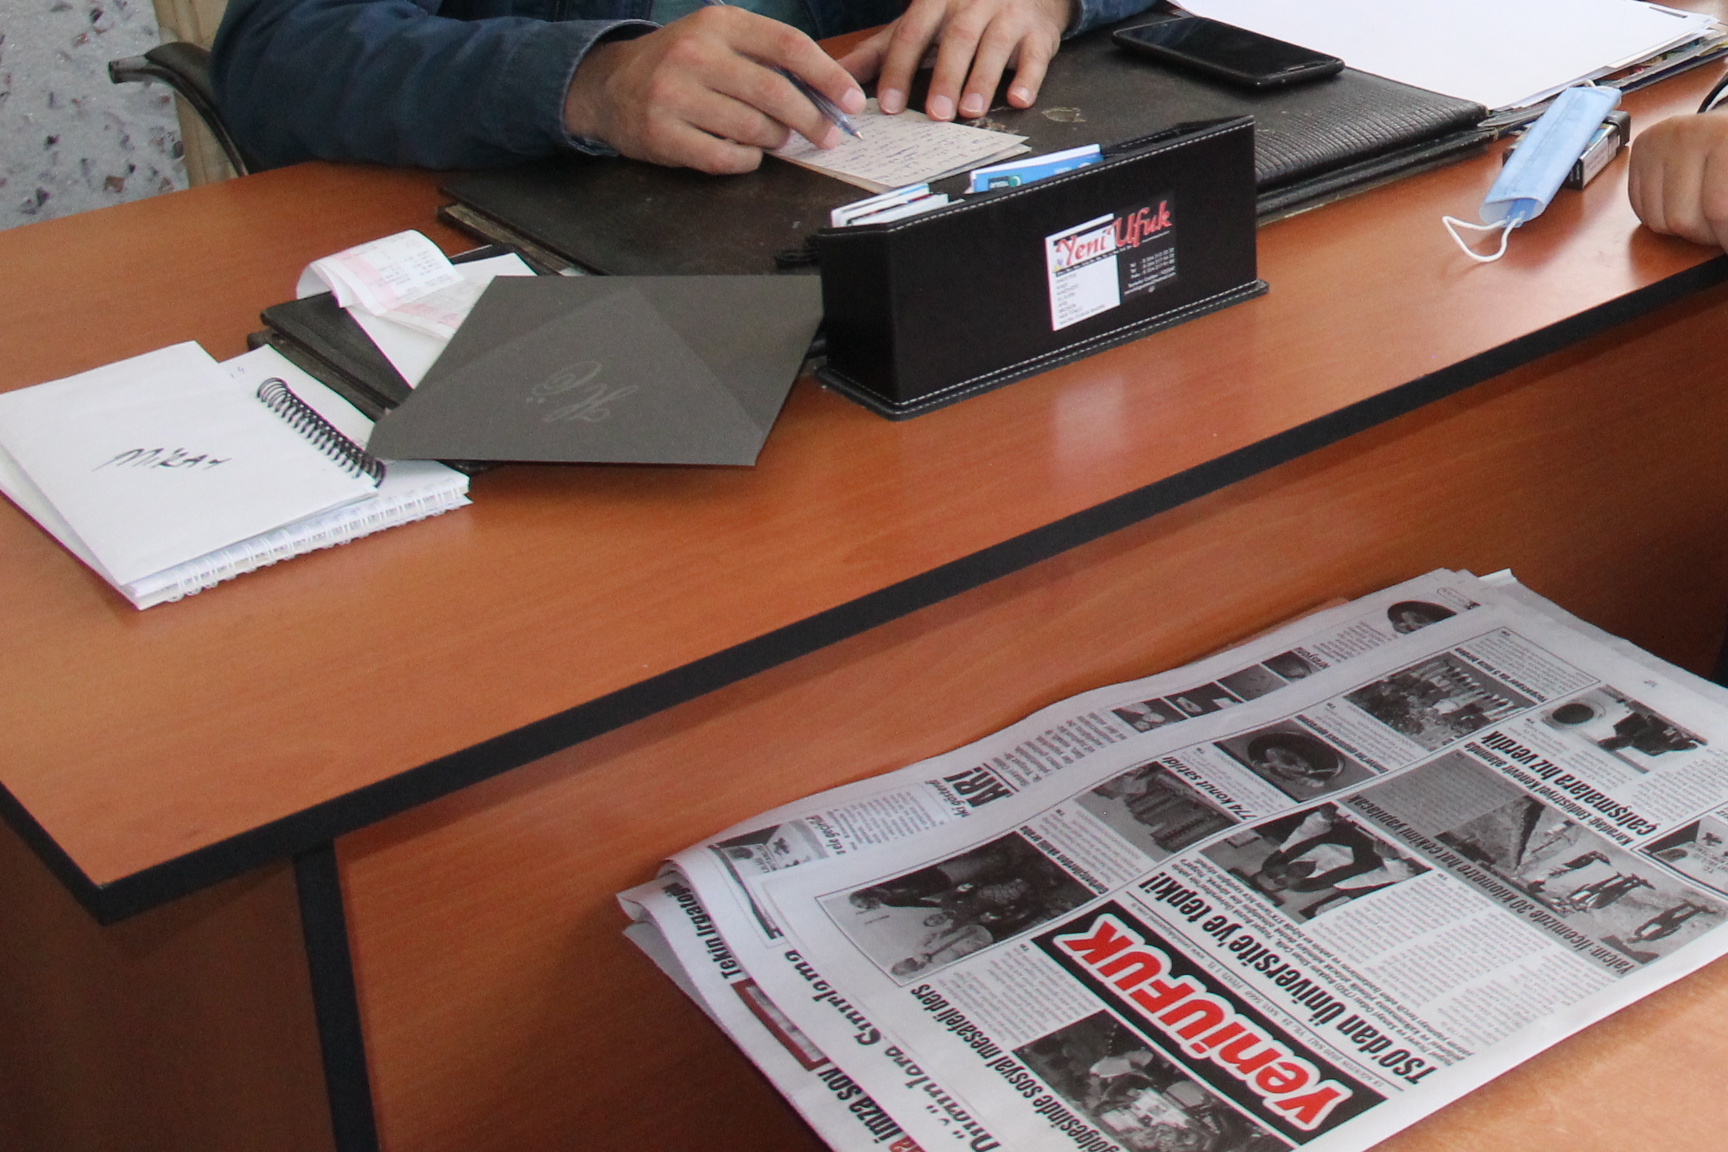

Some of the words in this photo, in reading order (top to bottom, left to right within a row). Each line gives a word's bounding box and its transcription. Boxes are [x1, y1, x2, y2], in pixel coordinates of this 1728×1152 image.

[1055, 234, 1108, 266] Yeni
[1112, 199, 1173, 248] Ufuk
[1464, 741, 1507, 768] alanında
[1481, 730, 1539, 765] verdik
[944, 766, 1012, 807] AR!
[1161, 756, 1202, 781] satıldı
[1501, 764, 1541, 790] Kenevir
[1529, 759, 1563, 781] hız
[1195, 780, 1235, 805] konut
[1533, 785, 1592, 821] Endüstriyel
[1554, 774, 1657, 836] çalışmalara
[1227, 803, 1257, 821] 774
[1347, 794, 1407, 831] yapılacak
[1434, 851, 1463, 869] hat
[1139, 872, 1212, 923] tepki!
[1456, 864, 1518, 904] kilometre
[1508, 899, 1535, 915] 30
[1528, 909, 1594, 951] İlçemizde
[705, 936, 743, 979] Tekin
[1202, 915, 1345, 1025] Üniversite'ye
[910, 983, 949, 1012] ders
[933, 1007, 1001, 1059] mesafeli
[1337, 1015, 1436, 1085] TSO'dan
[985, 1055, 1043, 1099] sosyal
